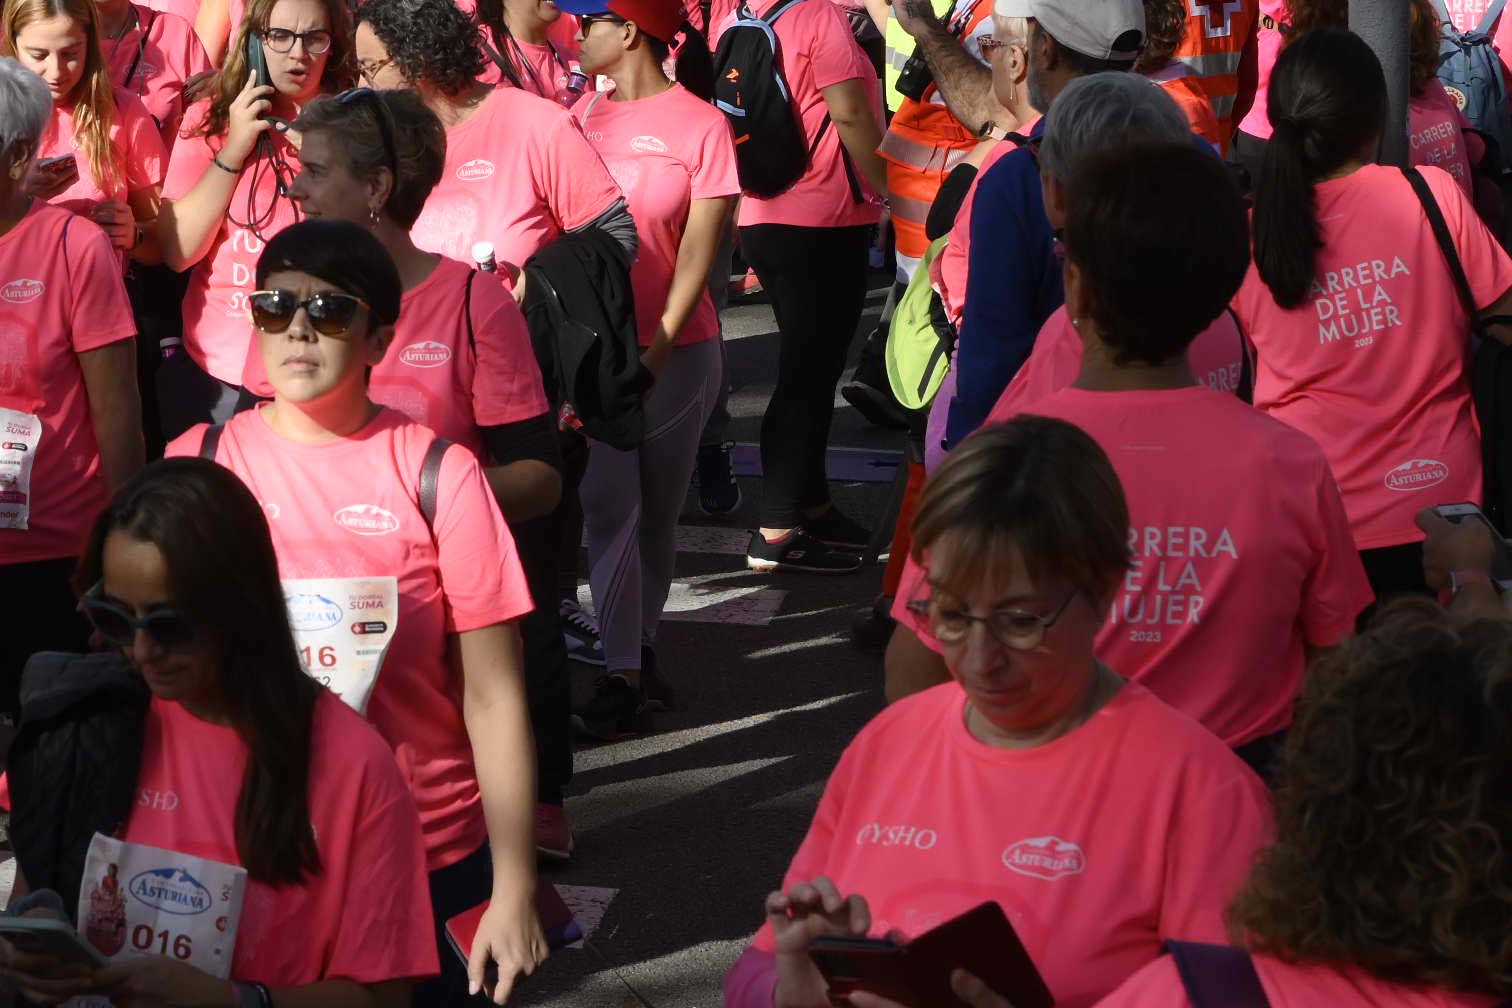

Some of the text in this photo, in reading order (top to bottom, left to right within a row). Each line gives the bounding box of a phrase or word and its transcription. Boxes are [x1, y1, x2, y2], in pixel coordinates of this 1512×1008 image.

[1315, 283, 1392, 321] DE LA
[1319, 305, 1403, 345] MUJER
[6, 426, 32, 437] SUMA
[1388, 468, 1446, 488] ASTURIANA
[1157, 560, 1202, 592] LA
[349, 599, 385, 611] SUMA
[1129, 630, 1161, 642] 2023
[138, 878, 205, 909] ASTURIANA
[131, 924, 193, 961] 016
